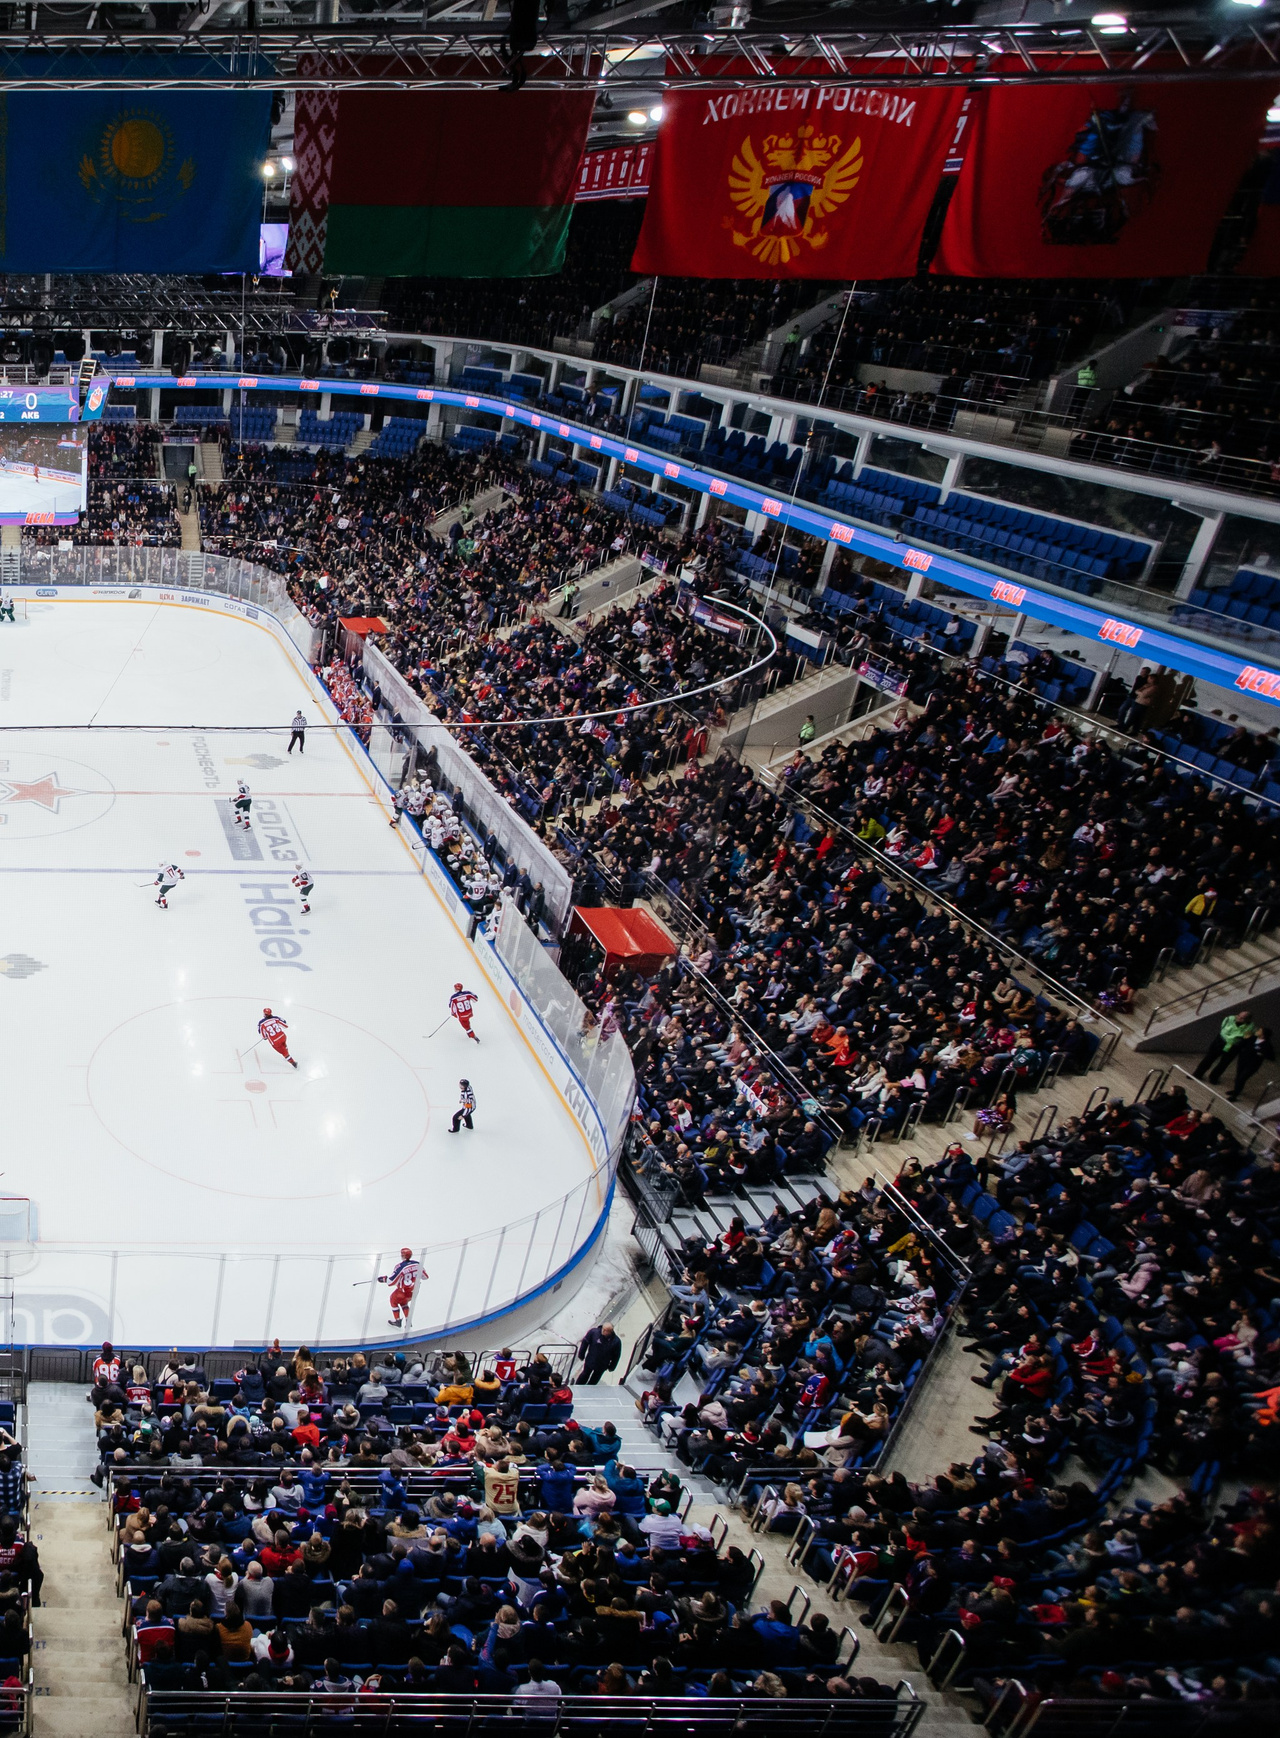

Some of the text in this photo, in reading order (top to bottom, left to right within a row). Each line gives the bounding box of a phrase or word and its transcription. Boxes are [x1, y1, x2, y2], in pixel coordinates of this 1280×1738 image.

[816, 88, 917, 127] РОССИИ
[25, 393, 37, 410] 0
[21, 411, 40, 420] АКБ
[762, 498, 783, 516] ЦСКА
[25, 512, 55, 525] ЦСКА
[831, 523, 855, 543] ЦСКА
[904, 549, 933, 572] ЦСКА
[37, 589, 57, 597] durex
[159, 593, 210, 606] ЦСКА ЗАРЯЖАЕТ
[992, 580, 1026, 606] ЦСКА
[224, 602, 246, 614] СОГАЗ
[1099, 619, 1143, 648] ЦСКА
[190, 736, 221, 789] РОСНЕФТЬ
[252, 799, 299, 862] СОГАЗ
[240, 883, 313, 972] Haier
[456, 1000, 471, 1013] 98
[522, 1013, 555, 1066] mastercard
[740, 1085, 763, 1115] ЦСКА
[563, 1077, 607, 1165] KHL.RU
[503, 1366, 512, 1379] 7
[491, 1484, 516, 1505] 25
[35, 1687, 51, 1696] 12
